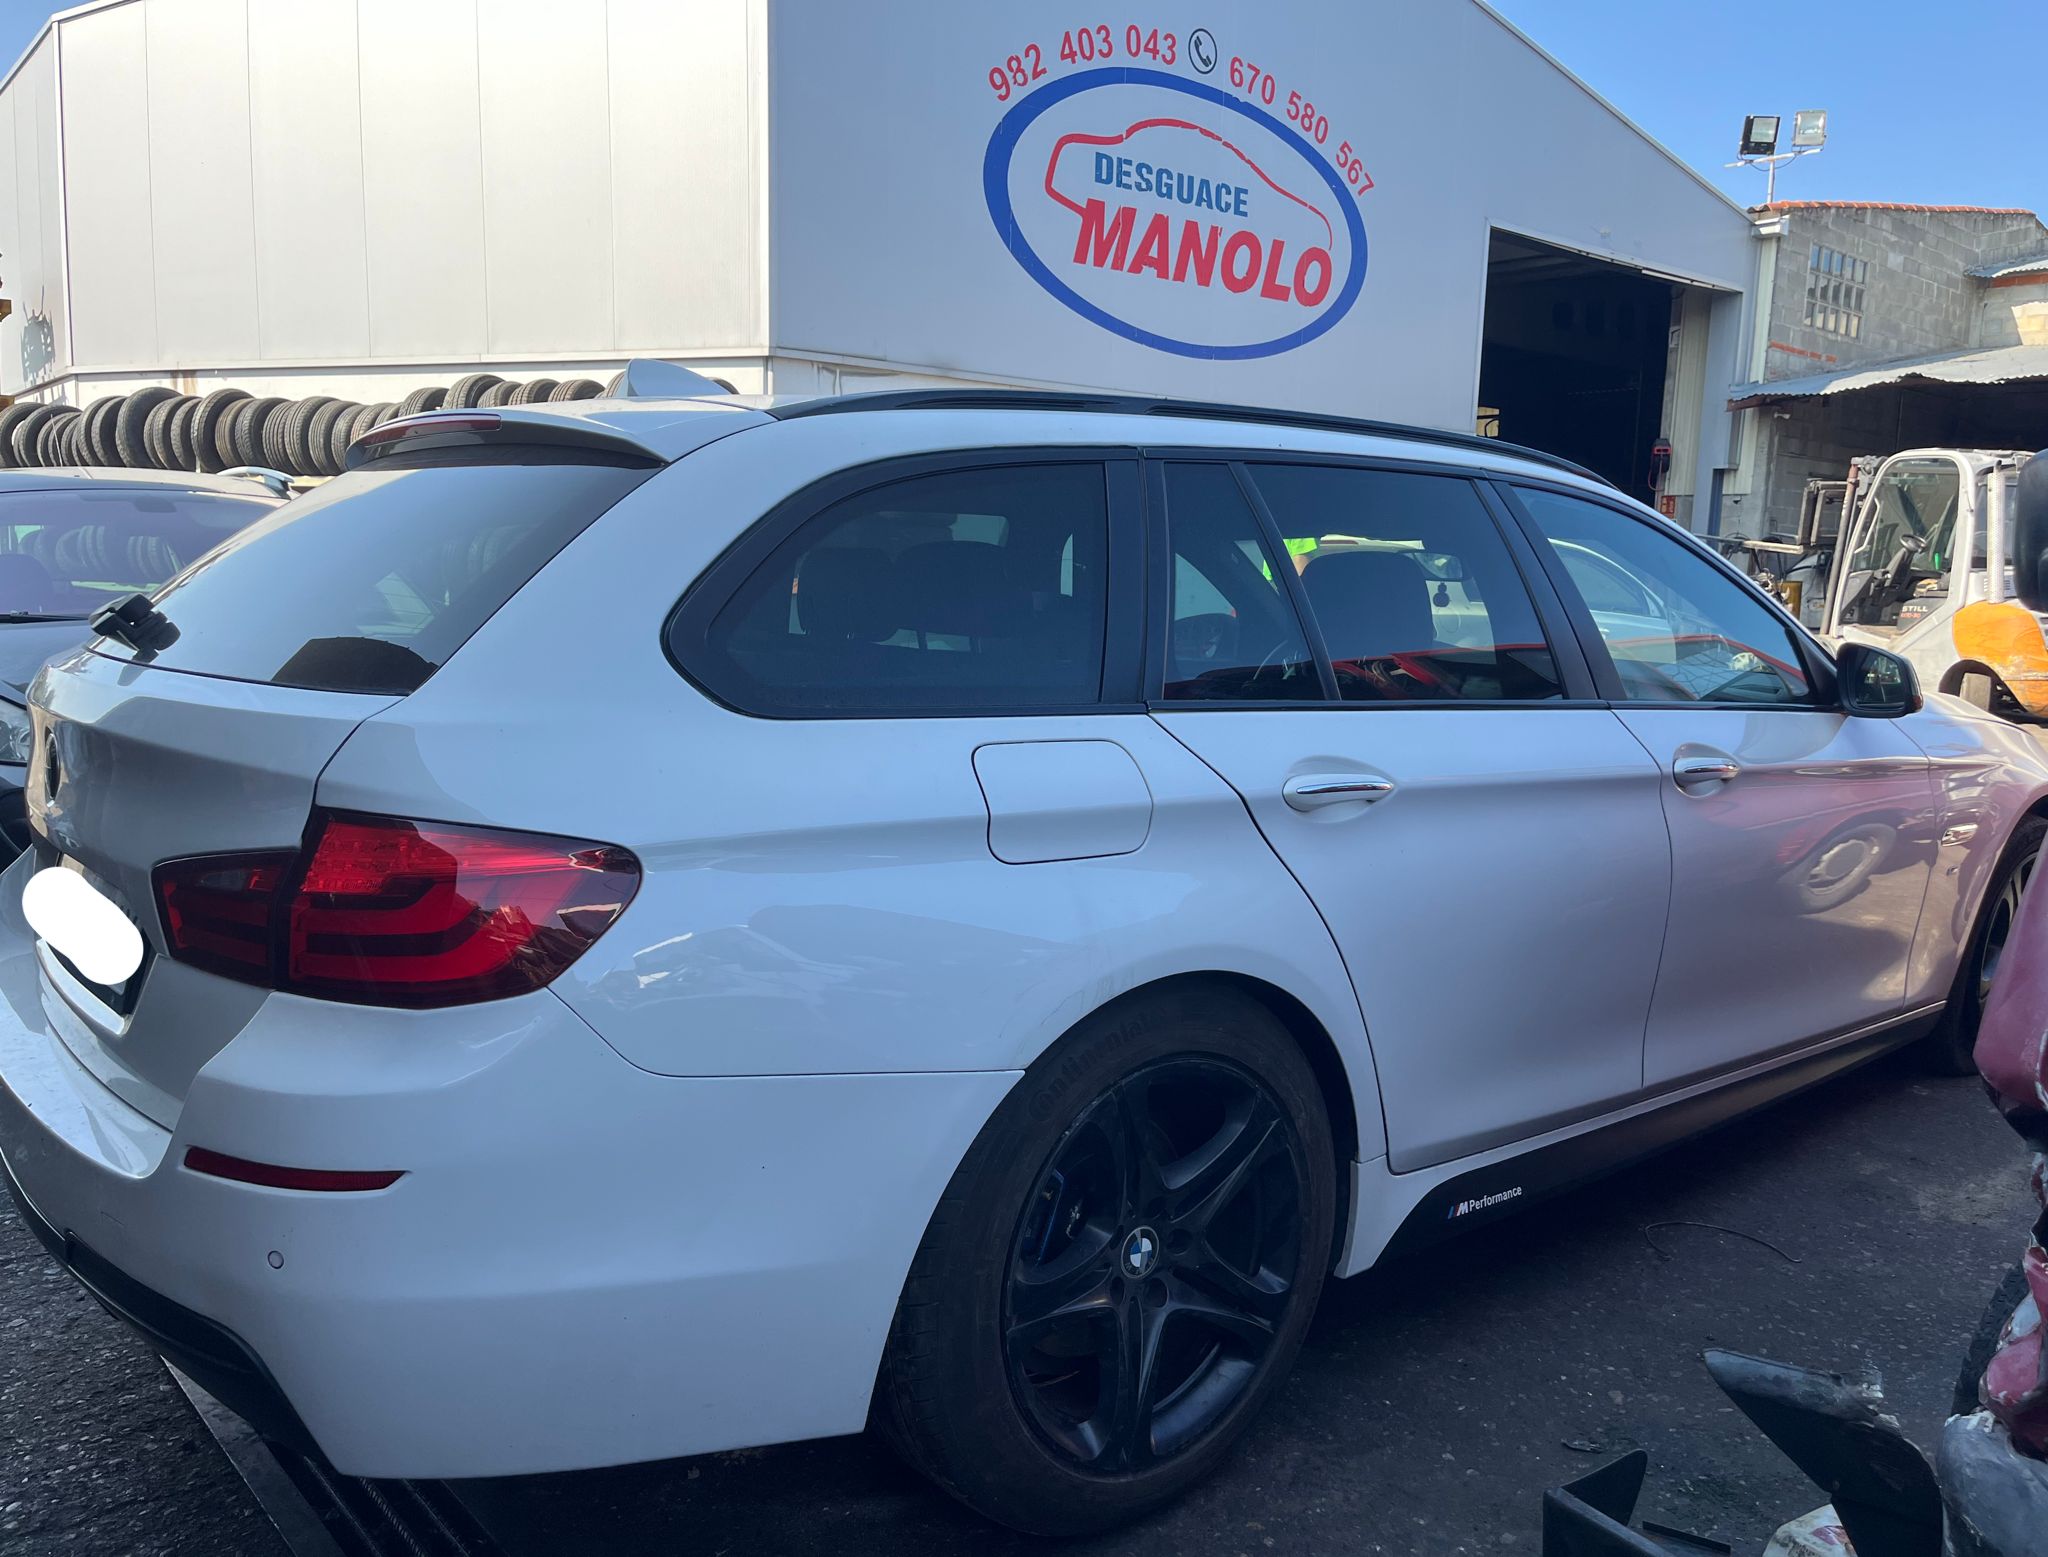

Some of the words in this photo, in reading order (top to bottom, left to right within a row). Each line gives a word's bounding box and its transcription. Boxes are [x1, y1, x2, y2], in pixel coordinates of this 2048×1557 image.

[988, 43, 1047, 102] 982
[1060, 24, 1113, 65] 403
[1126, 24, 1177, 65] 043
[1229, 56, 1275, 105] 670
[1286, 90, 1329, 144] 580
[1335, 141, 1375, 197] 567
[1094, 152, 1249, 217] DESGUACE
[1073, 198, 1333, 307] MANOLO
[1469, 1186, 1522, 1212] Performance
